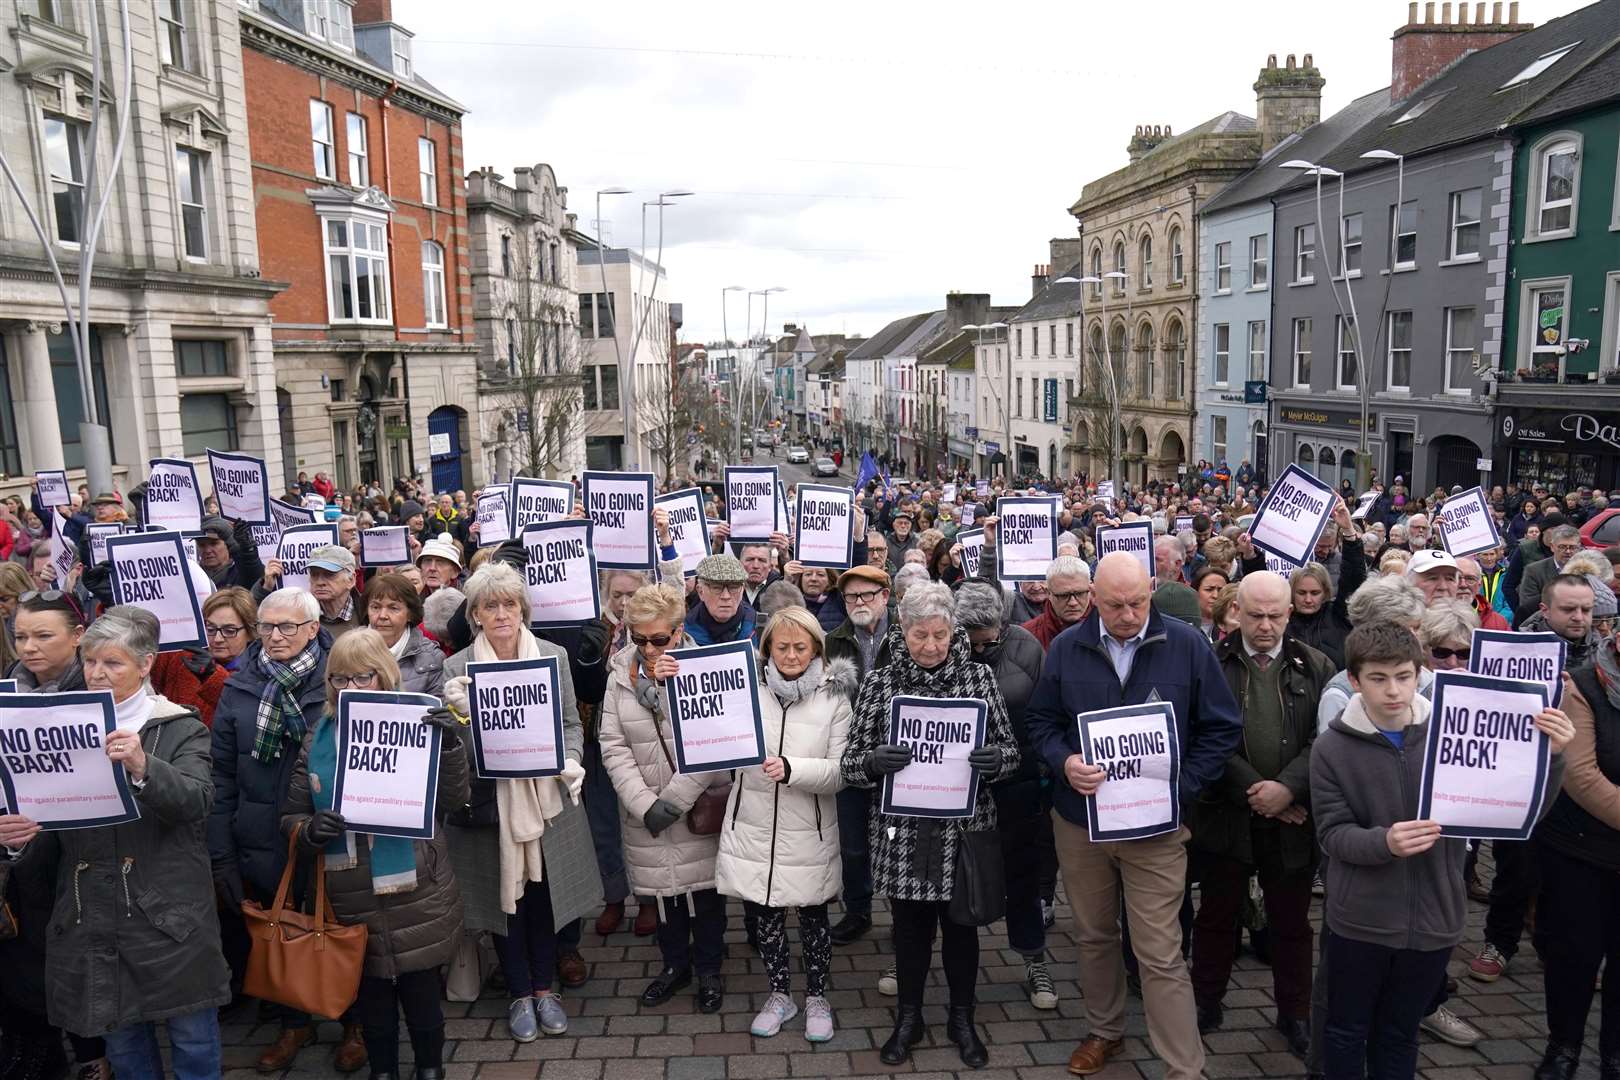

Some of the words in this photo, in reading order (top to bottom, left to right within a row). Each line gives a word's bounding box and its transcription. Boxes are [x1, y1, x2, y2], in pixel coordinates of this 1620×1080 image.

[1504, 418, 1512, 433] 9
[1518, 429, 1528, 437] Off
[1529, 429, 1546, 438] Sales
[1560, 414, 1620, 442] Da
[148, 473, 161, 488] NO
[163, 473, 192, 489] GOING
[215, 466, 227, 481] NO
[228, 470, 259, 484] GOING
[149, 488, 180, 503] BACK!
[216, 480, 244, 498] BACK!
[730, 482, 742, 496] NO
[744, 482, 771, 496] GOING
[1278, 482, 1294, 500] NO
[1292, 490, 1323, 515] GOING
[479, 503, 486, 513] NO
[487, 501, 504, 512] GOING
[519, 496, 533, 511] NO
[535, 496, 565, 514] GOING
[590, 492, 606, 510] NO
[609, 492, 644, 511] GOING
[731, 497, 757, 511] BACK!
[803, 500, 816, 515] NO
[818, 501, 847, 517] GOING
[1269, 496, 1302, 522] BACK!
[590, 511, 625, 529] BACK!
[668, 506, 697, 526] GOING
[1003, 514, 1017, 529] NO
[1018, 514, 1049, 529] GOING
[1441, 510, 1454, 523] NO
[1453, 501, 1480, 519] GOING
[802, 516, 831, 531] BACK!
[1445, 517, 1470, 534] BACK!
[255, 534, 278, 546] BACK!
[1003, 529, 1033, 545] BACK!
[1103, 539, 1117, 553] NO
[1119, 537, 1146, 552] GOING
[282, 543, 296, 560] NO
[525, 544, 544, 565] NO
[546, 539, 585, 562] GOING
[965, 545, 978, 559] NO
[117, 559, 138, 581] NO
[138, 556, 180, 578] GOING
[527, 562, 567, 587] BACK!
[1266, 559, 1279, 571] NO
[122, 580, 165, 603] BACK!
[1481, 657, 1503, 677] NO
[1507, 657, 1553, 681] GOING
[676, 674, 698, 698] NO
[700, 668, 746, 695] GOING
[479, 687, 500, 709] NO
[503, 683, 548, 708] GOING
[679, 694, 725, 721] BACK!
[481, 708, 526, 731] BACK!
[1444, 706, 1470, 736] NO
[1474, 709, 1535, 743] GOING
[0, 728, 31, 755] NO
[34, 723, 101, 752] GOING
[351, 719, 374, 744] NO
[378, 720, 428, 749] GOING
[901, 717, 922, 740] NO
[925, 720, 972, 744] GOING
[1093, 735, 1116, 761] NO
[1118, 731, 1166, 758] GOING
[1439, 737, 1499, 770] BACK!
[6, 752, 74, 775] BACK!
[348, 745, 399, 773] BACK!
